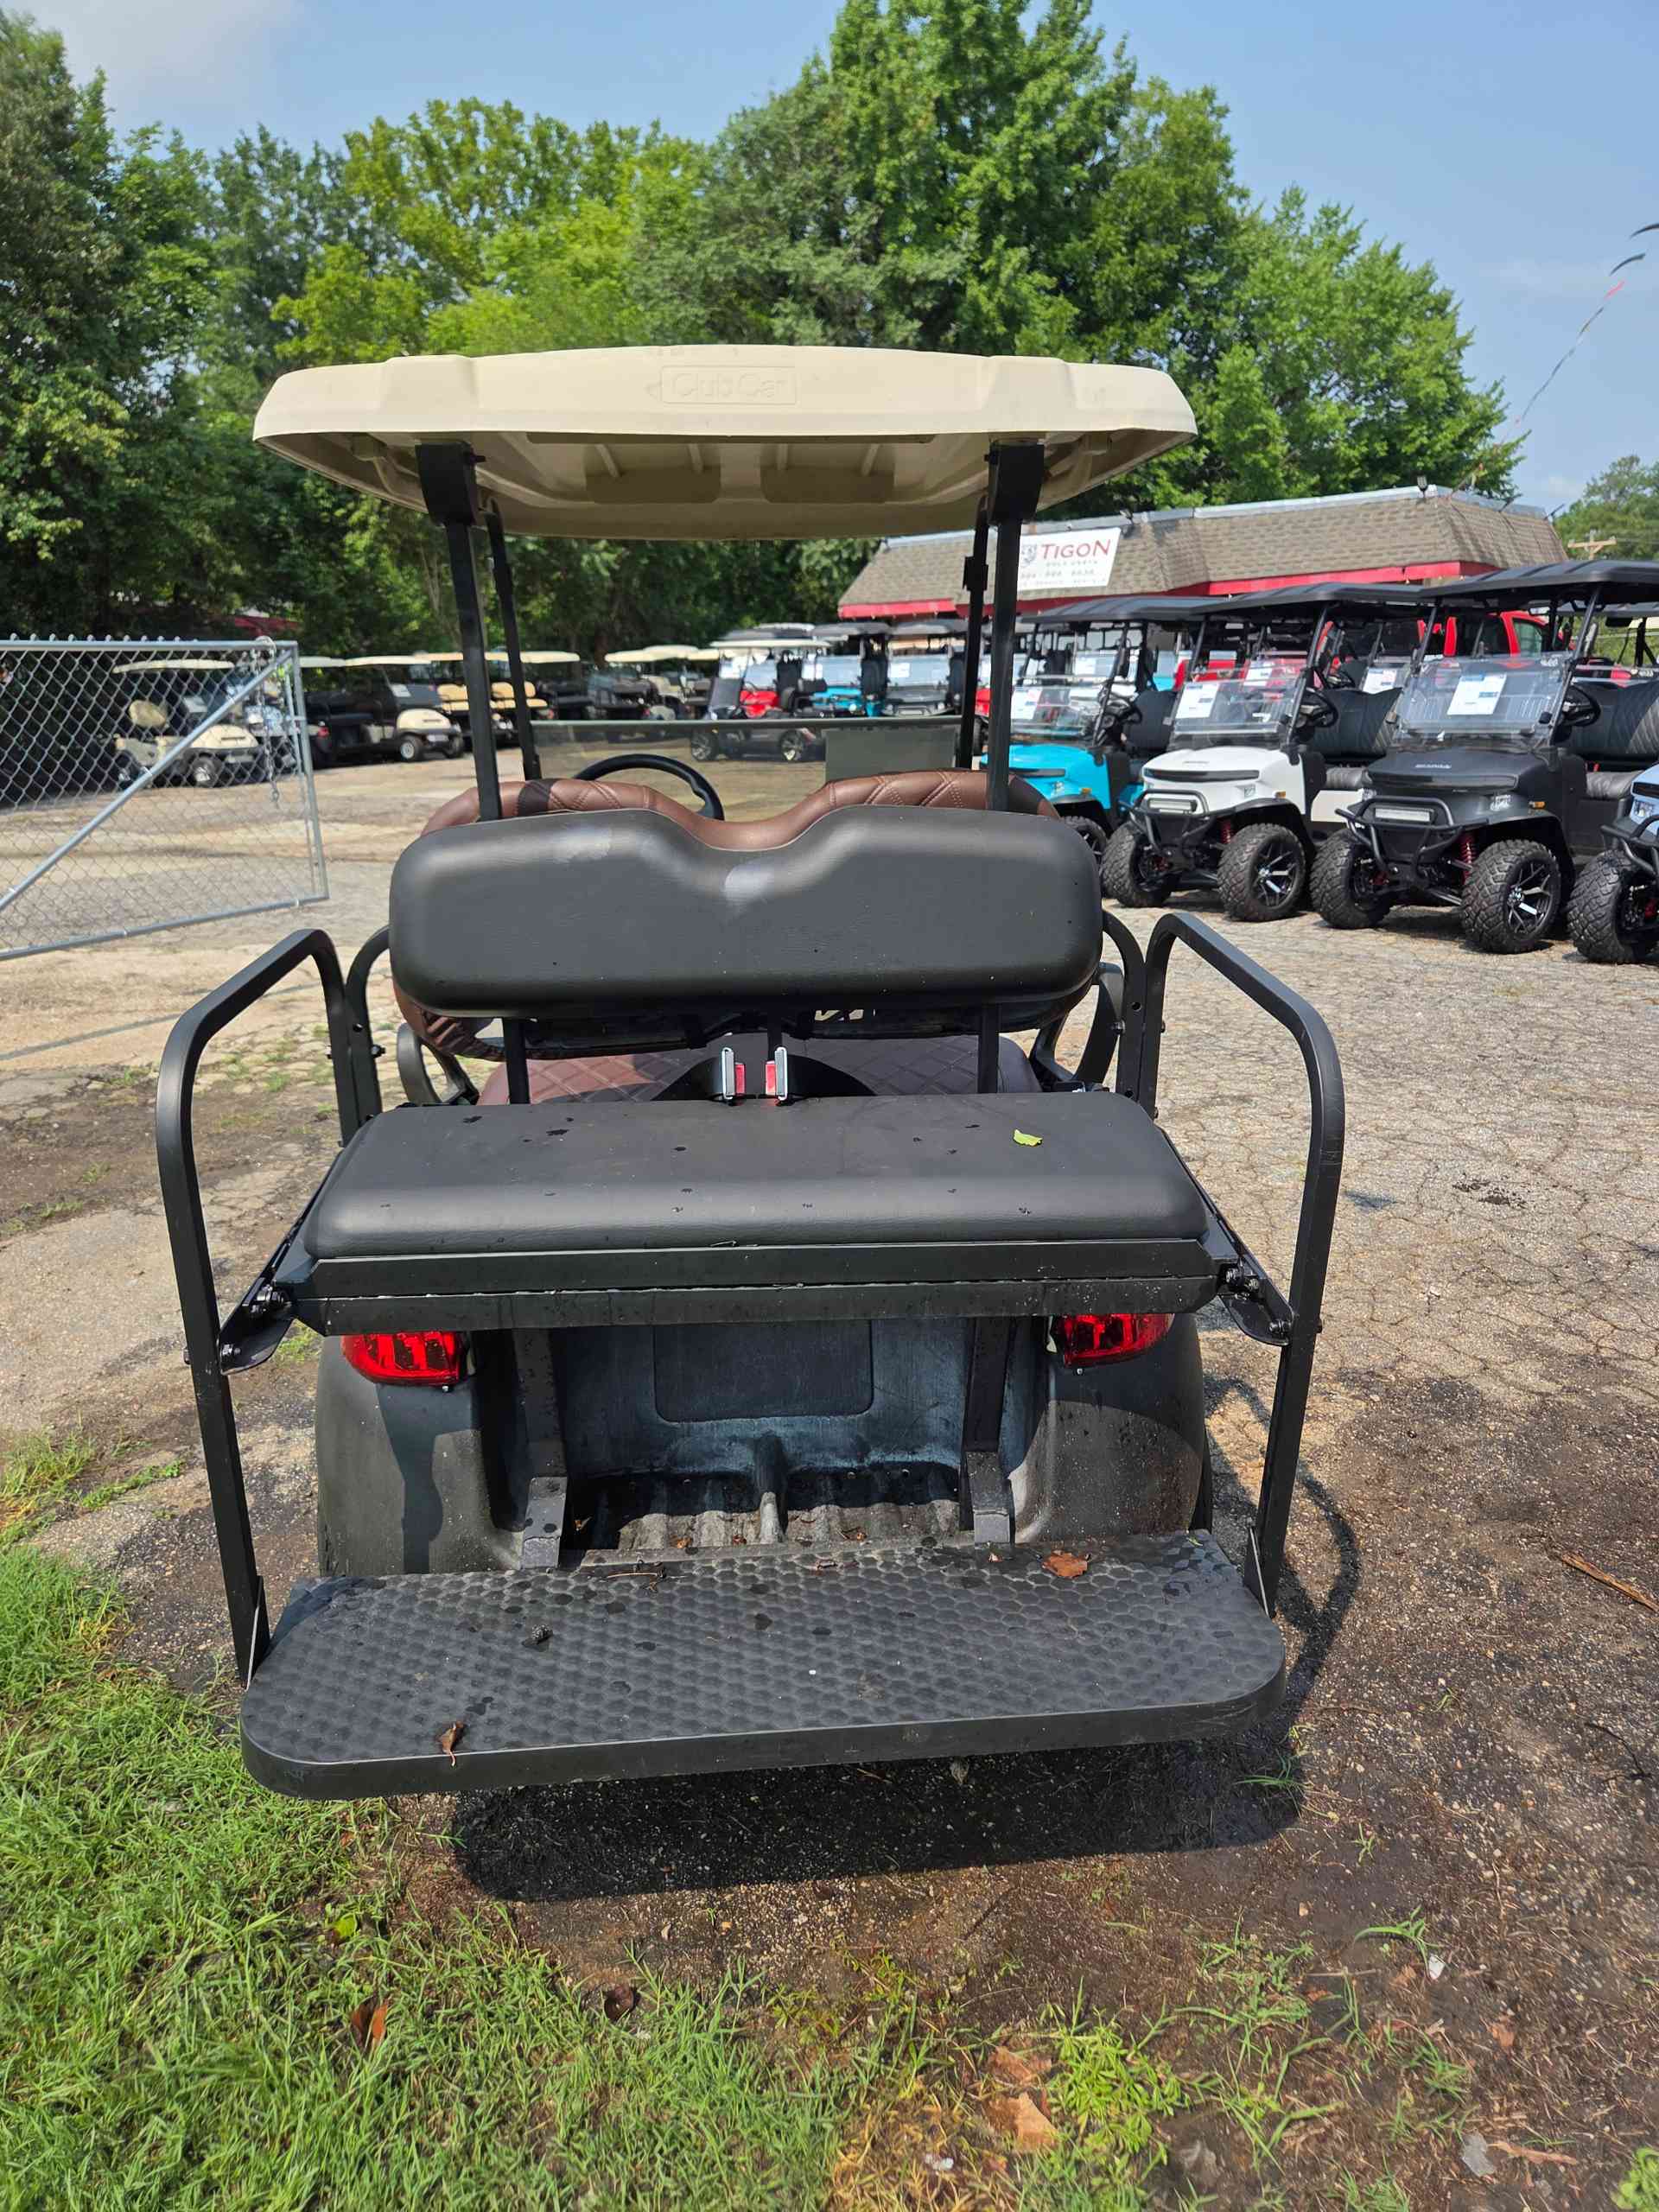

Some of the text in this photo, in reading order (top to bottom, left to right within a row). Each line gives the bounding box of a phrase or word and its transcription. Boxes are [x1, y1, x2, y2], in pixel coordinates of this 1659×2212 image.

[673, 372, 790, 397] Club Car
[1041, 538, 1111, 560] TIGON
